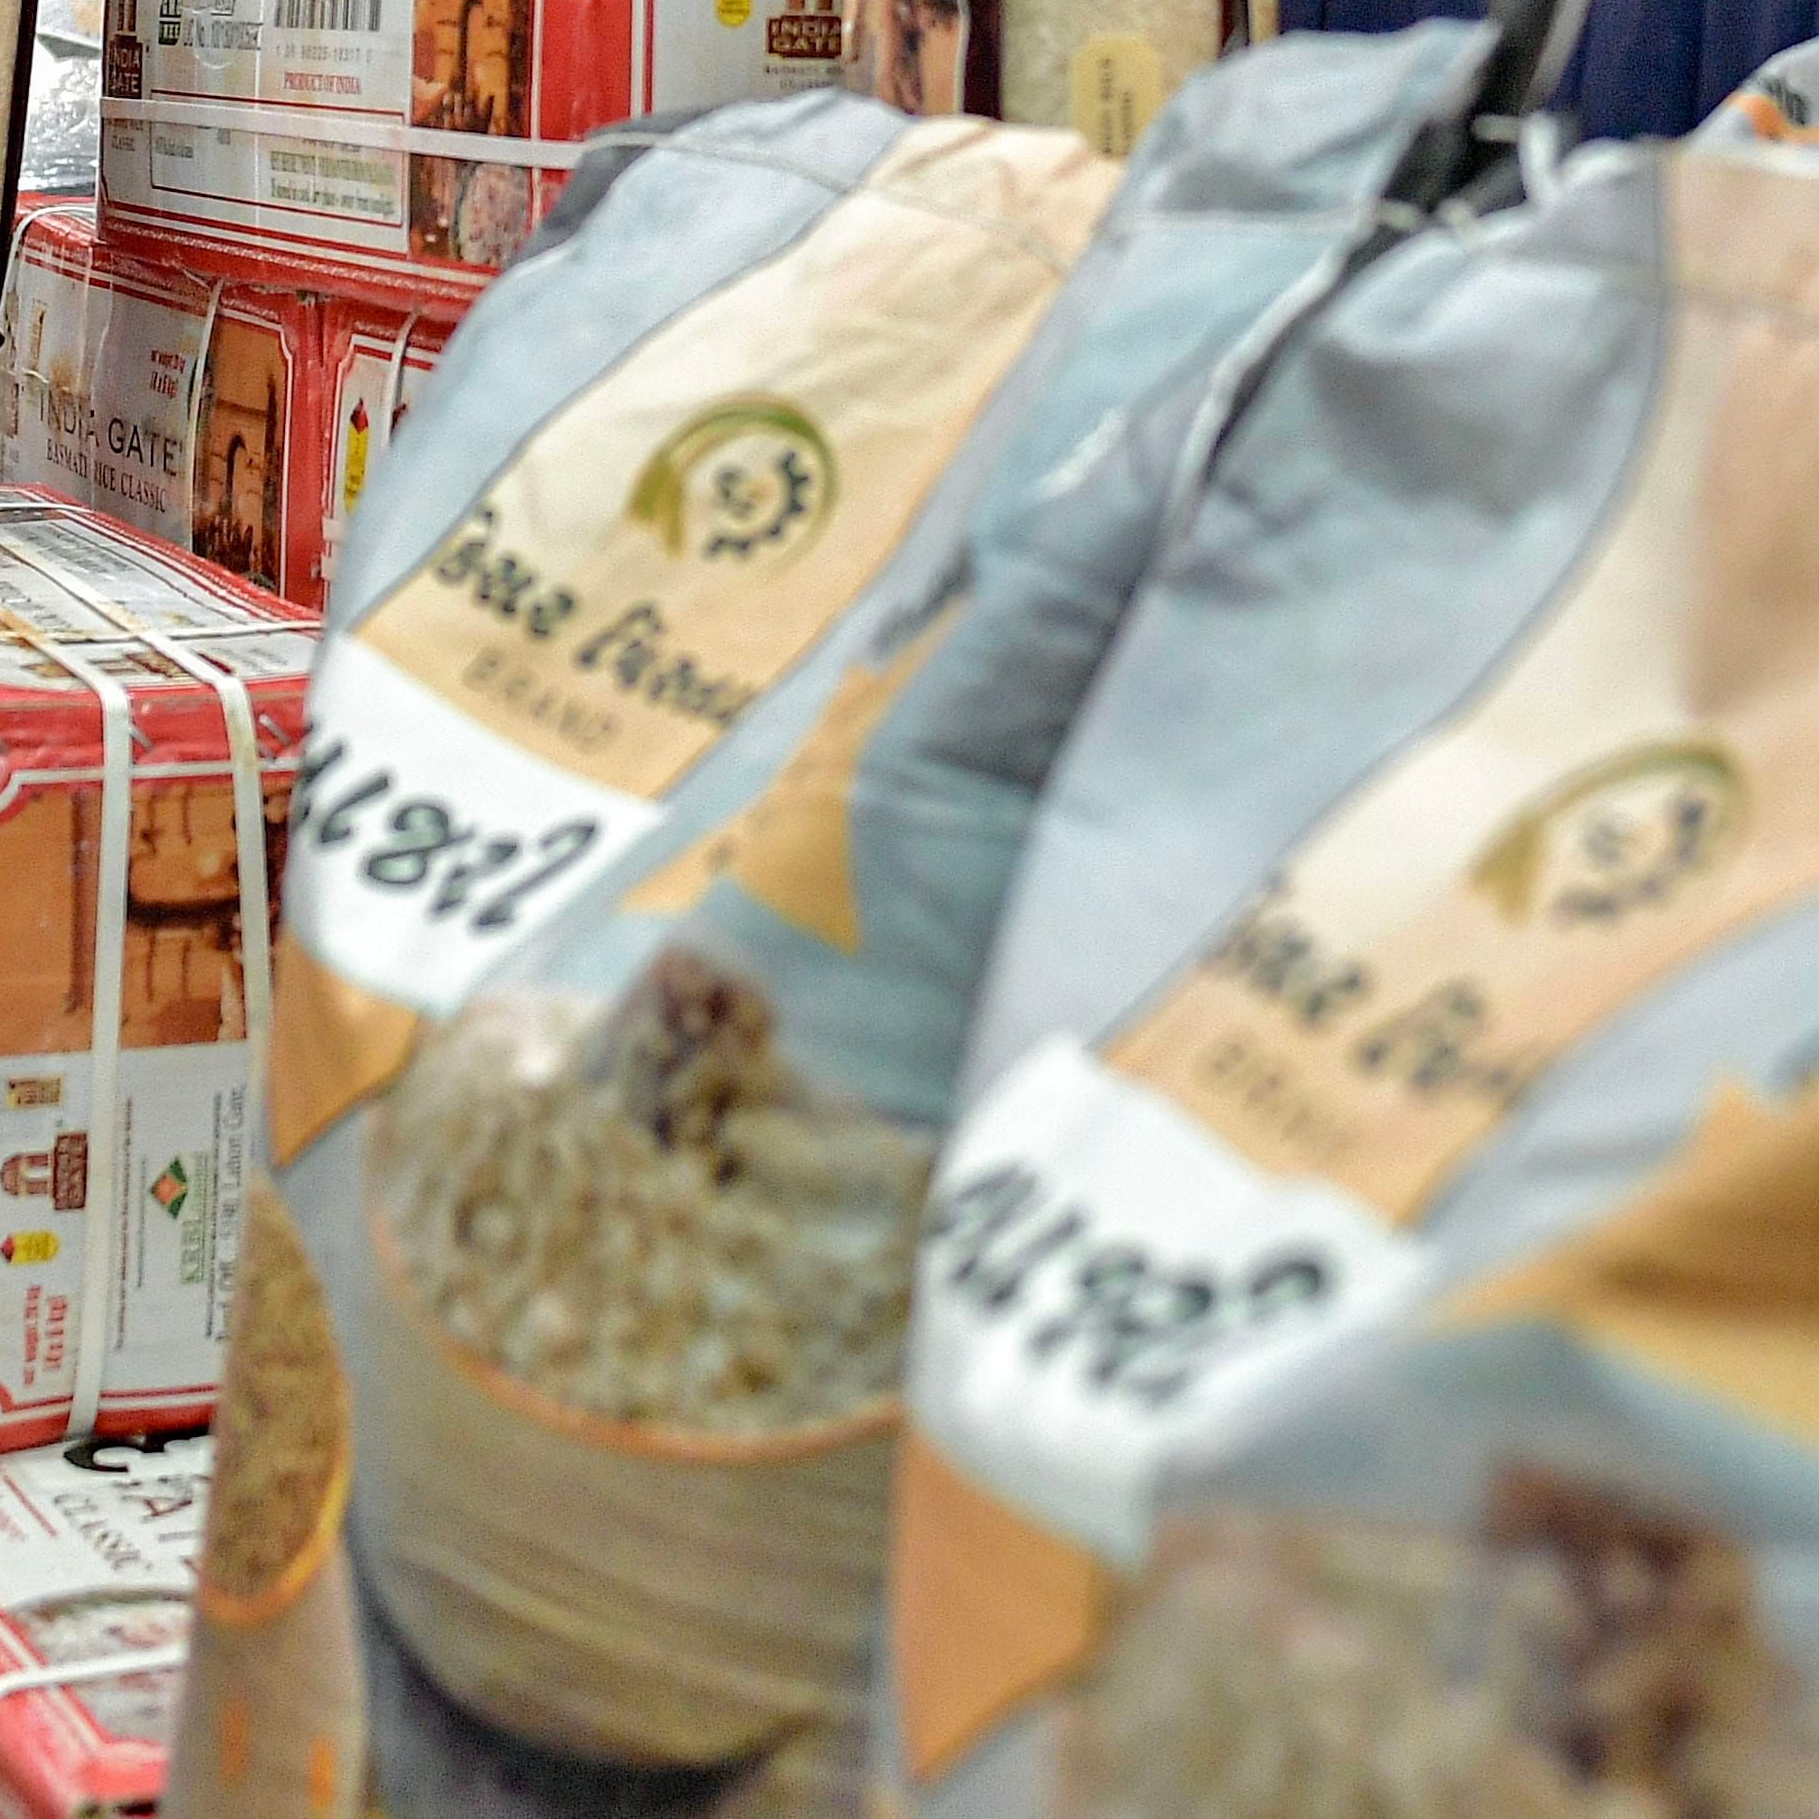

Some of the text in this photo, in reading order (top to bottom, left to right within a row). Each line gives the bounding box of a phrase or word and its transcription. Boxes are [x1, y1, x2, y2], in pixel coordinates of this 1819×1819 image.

[47, 438, 87, 479] BASMATI
[120, 471, 167, 513] CLASSIC
[107, 417, 178, 477] GATE
